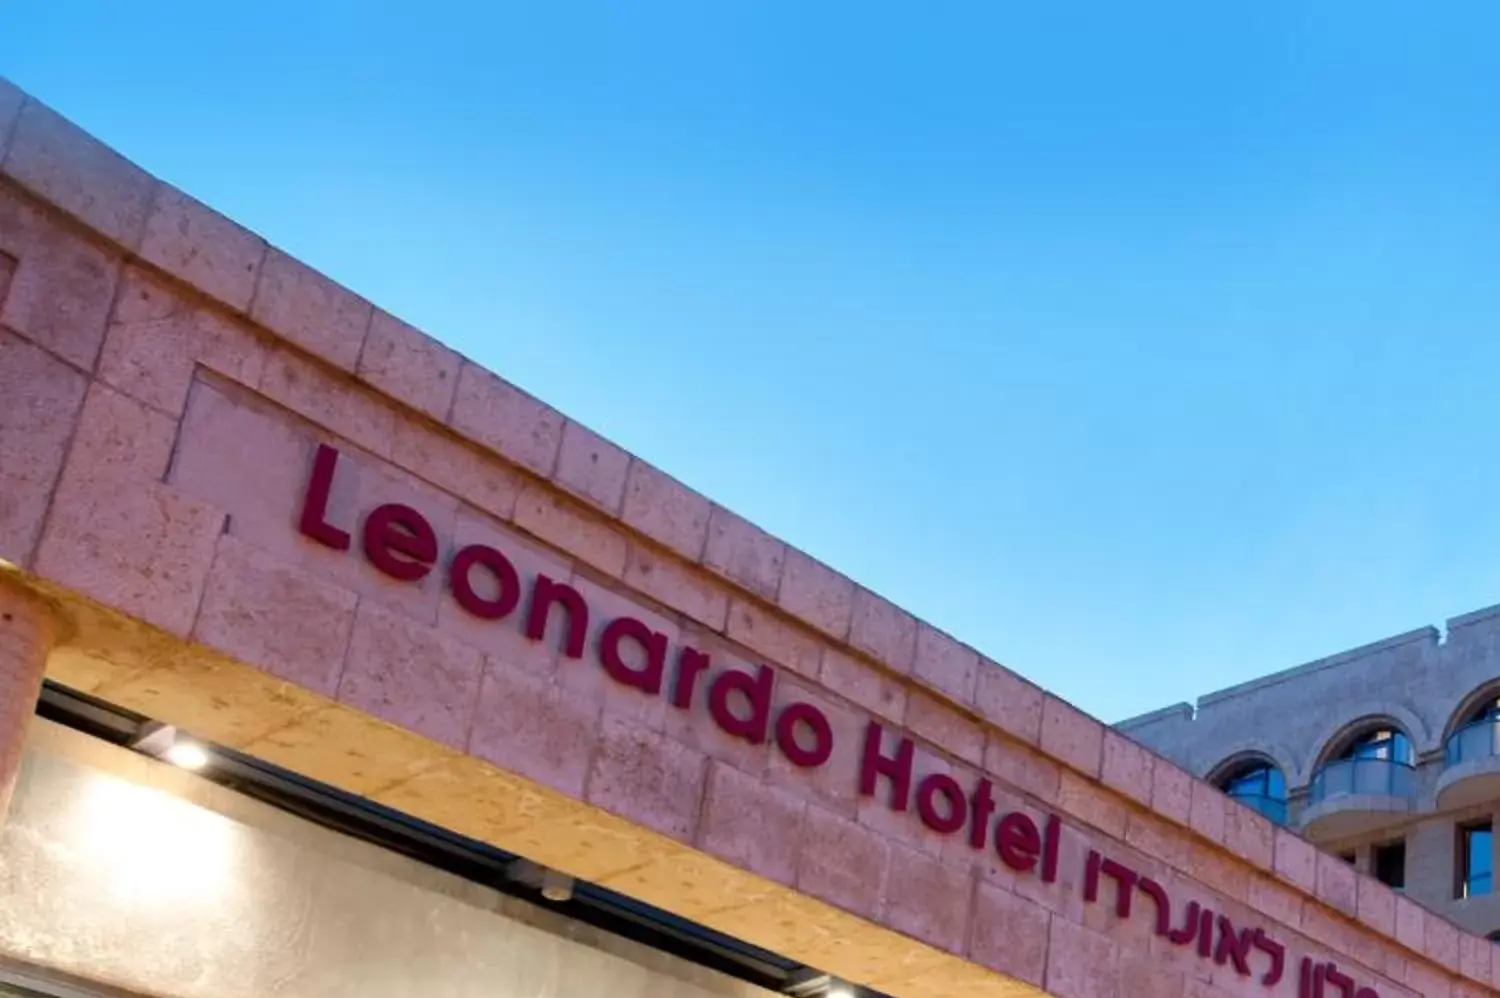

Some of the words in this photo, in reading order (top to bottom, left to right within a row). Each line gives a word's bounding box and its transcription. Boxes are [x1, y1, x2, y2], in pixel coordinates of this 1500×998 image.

[300, 443, 834, 768] Leonardo
[860, 720, 1061, 883] Hotel
[1084, 850, 1285, 986] לאונרדו
